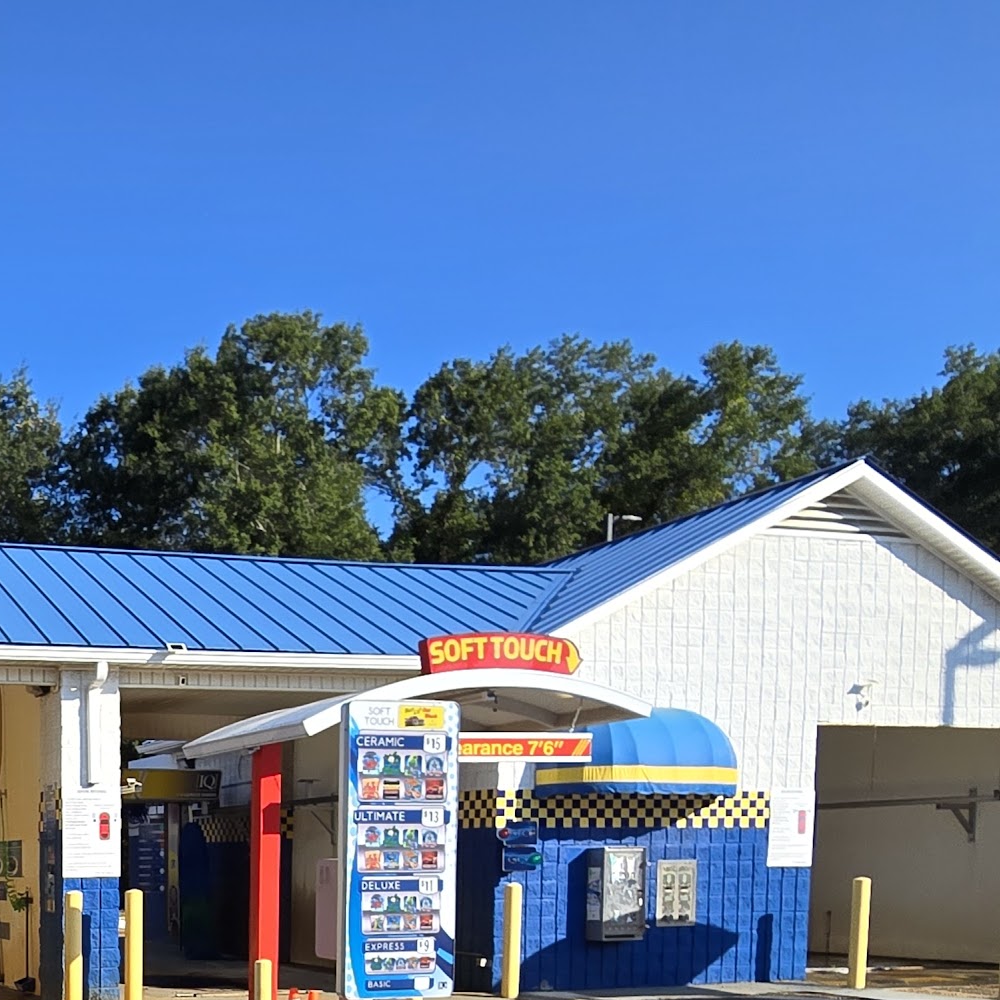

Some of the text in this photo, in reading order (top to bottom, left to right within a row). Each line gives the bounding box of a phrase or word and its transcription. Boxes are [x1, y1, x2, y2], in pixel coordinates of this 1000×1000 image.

[429, 636, 563, 665] SOFT TOUCH
[368, 706, 391, 716] SOFT
[364, 716, 395, 726] TOUCH
[356, 736, 405, 747] CERAMIC
[426, 737, 441, 750] $15
[354, 811, 405, 821] ULTIMATE
[424, 810, 439, 823] $13
[361, 881, 401, 891] DELUXE
[364, 942, 405, 951] EXPRESS
[367, 980, 391, 989] BASIC
